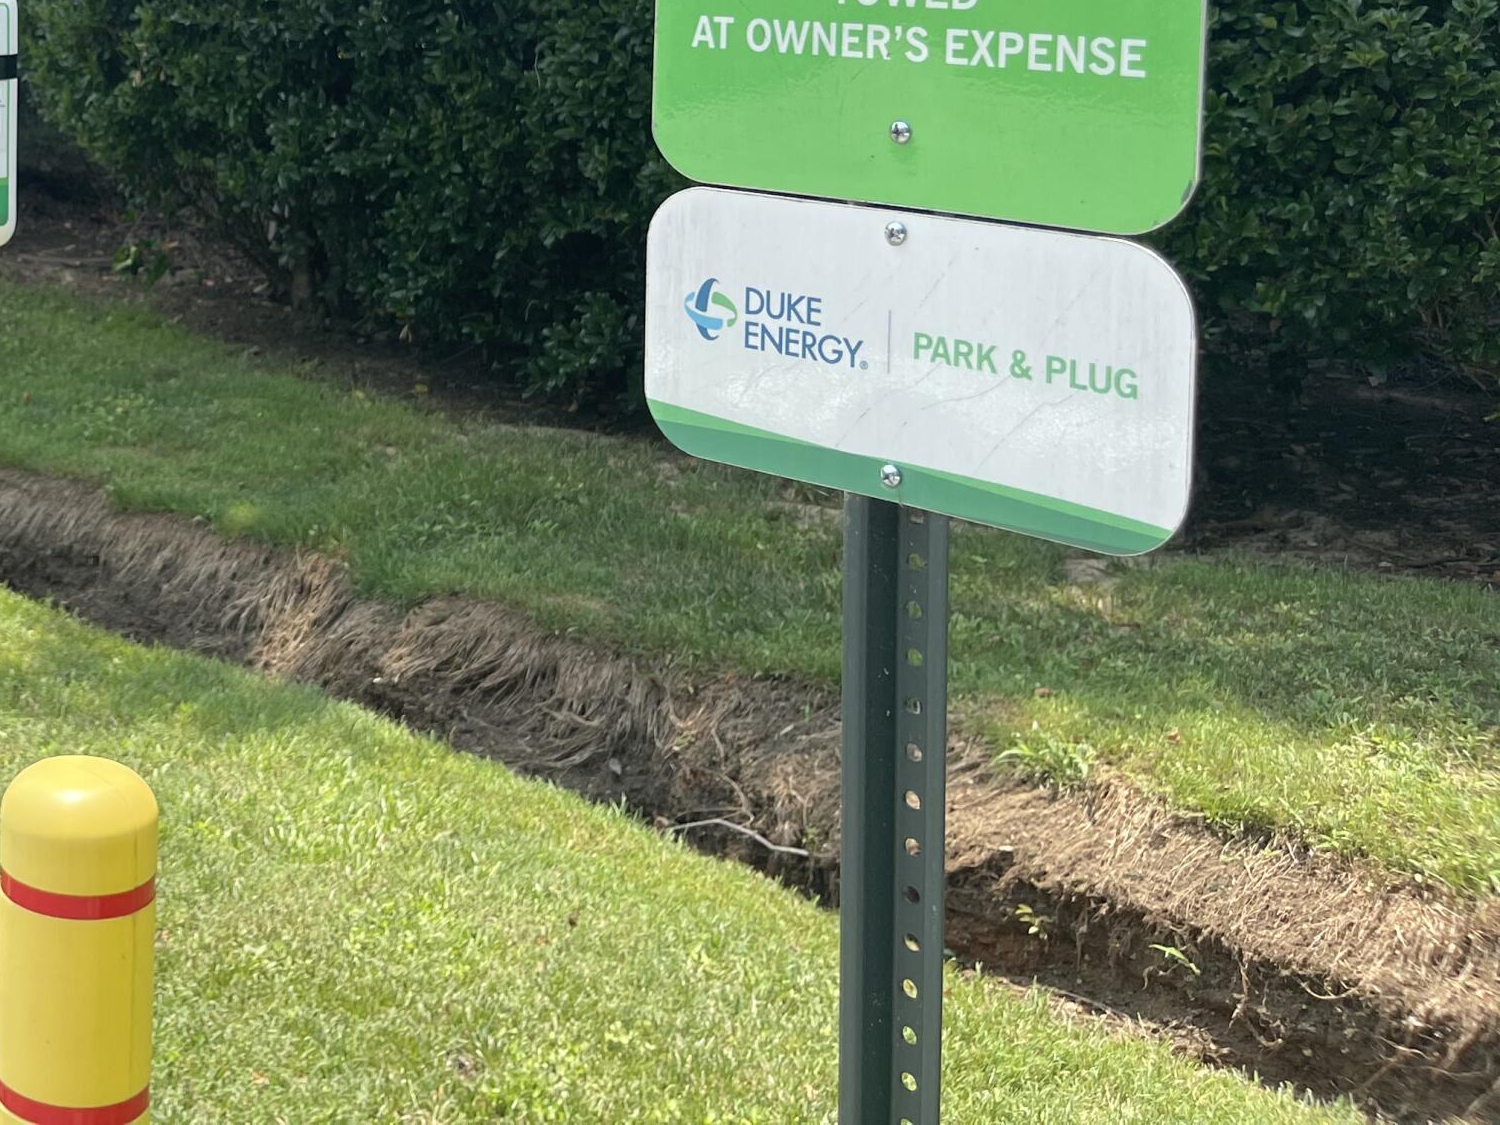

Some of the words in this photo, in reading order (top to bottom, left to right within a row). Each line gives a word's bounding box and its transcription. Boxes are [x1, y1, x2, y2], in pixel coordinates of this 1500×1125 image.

[691, 15, 735, 49] AT
[746, 18, 930, 63] OWNER'S
[944, 28, 1148, 79] EXPENSE
[744, 286, 822, 327] DUKE
[913, 331, 997, 375] PARK
[1009, 349, 1034, 382] &
[1046, 355, 1140, 400] PLUG
